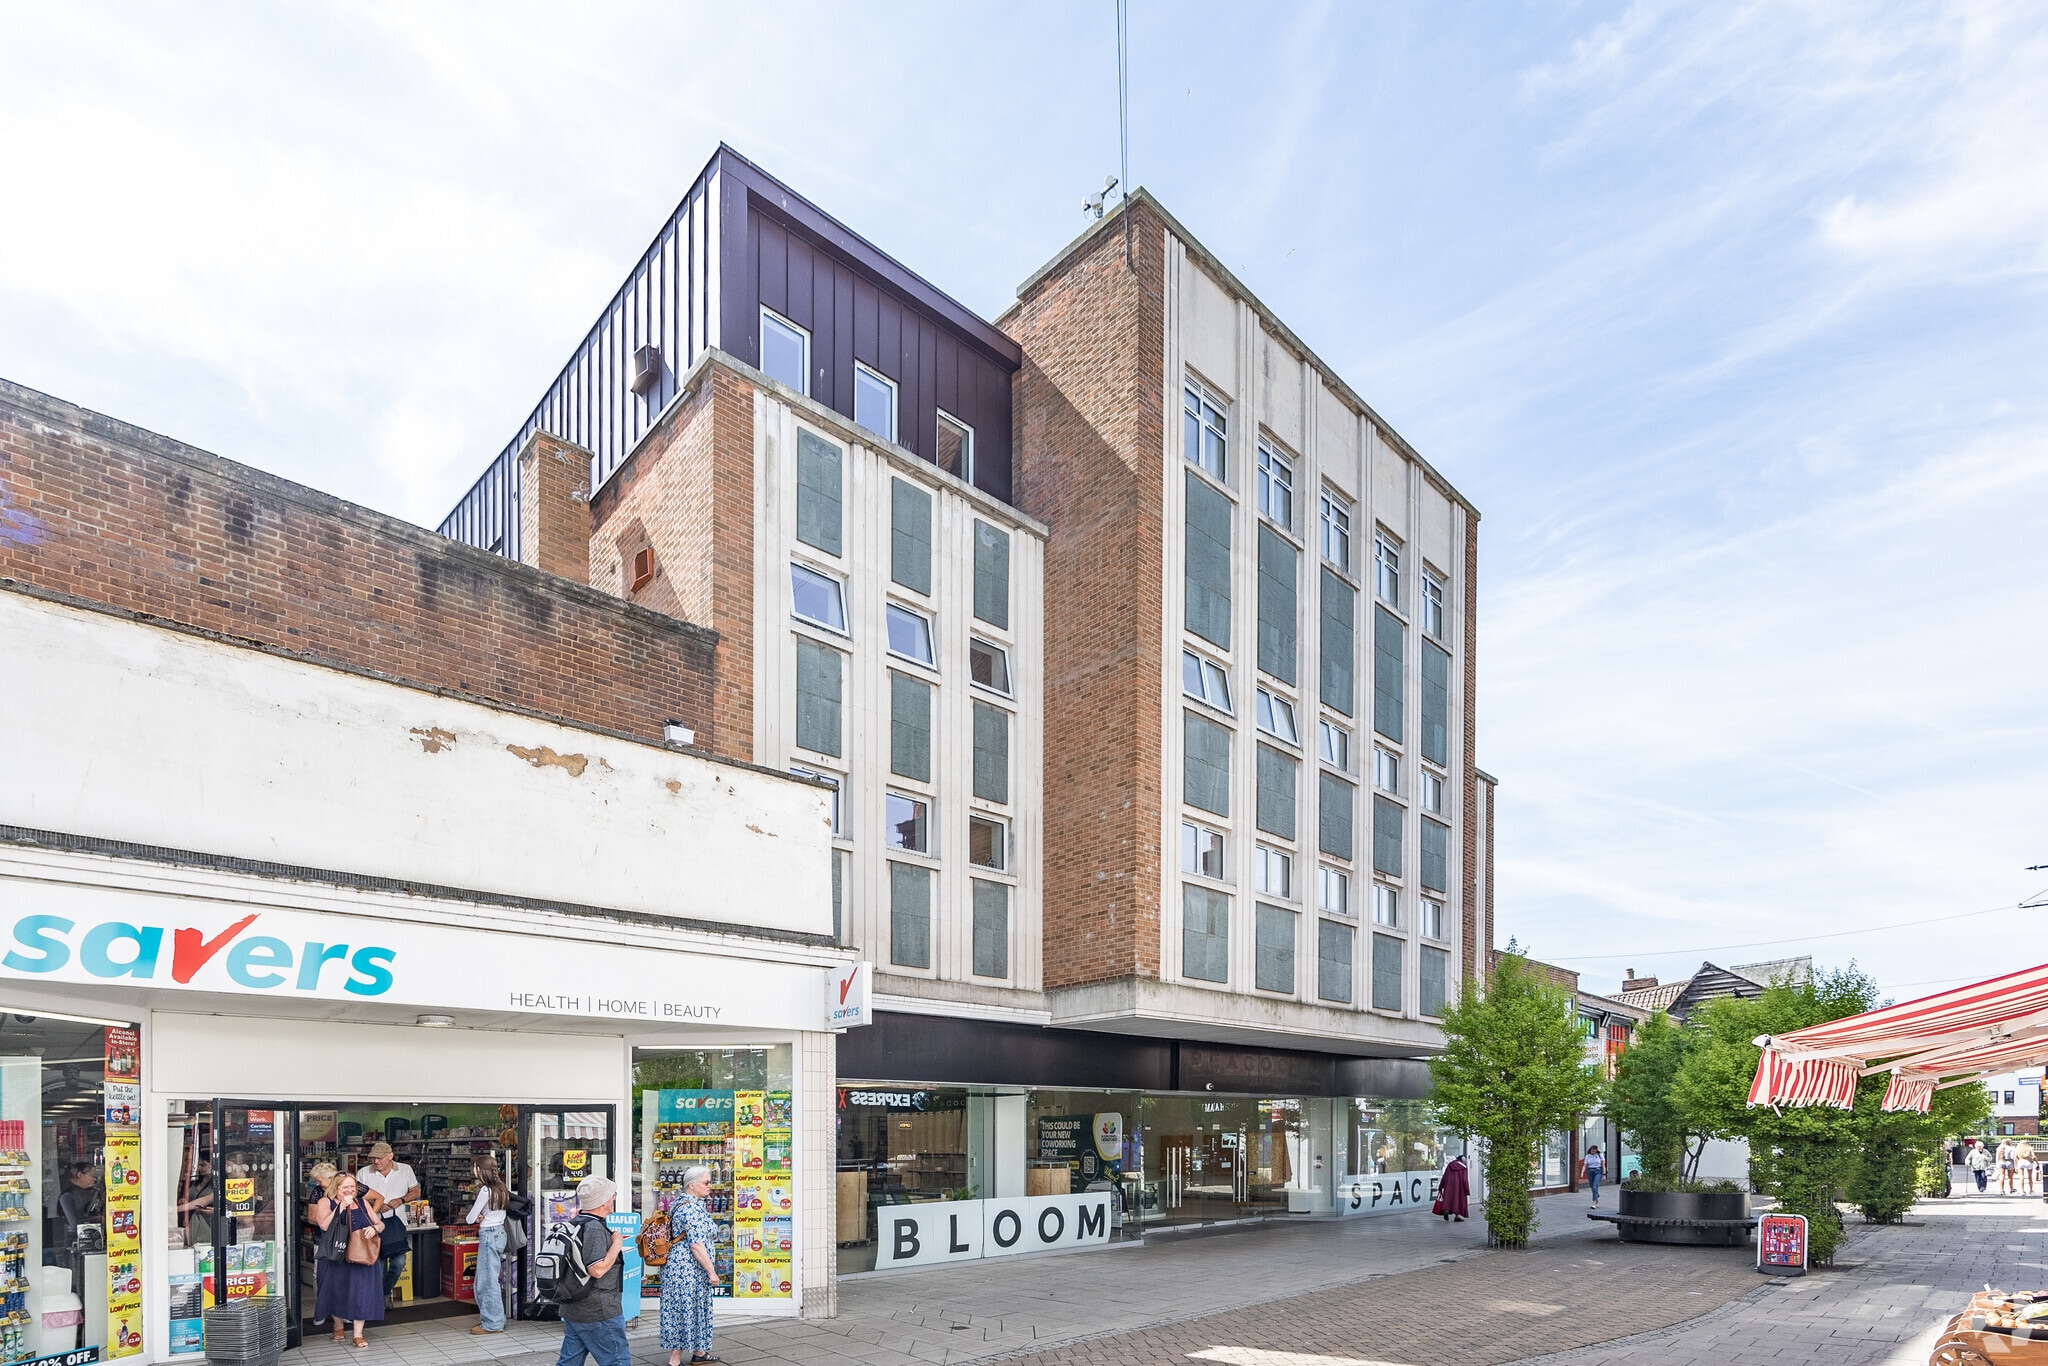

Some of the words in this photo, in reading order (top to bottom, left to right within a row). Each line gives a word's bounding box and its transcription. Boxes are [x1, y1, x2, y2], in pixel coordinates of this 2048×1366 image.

[2, 912, 397, 996] savers
[510, 992, 579, 1010] HEALTH
[598, 998, 648, 1015] HOME
[663, 1003, 721, 1019] BEAUTY
[833, 1005, 860, 1020] savers
[675, 1094, 732, 1109] savers
[306, 1114, 333, 1123] PRICE
[1042, 1121, 1054, 1130] THIS
[1054, 1121, 1073, 1130] COULD
[1074, 1121, 1081, 1130] BE
[1042, 1131, 1057, 1139] YOUR
[1058, 1131, 1071, 1139] NEW
[107, 1139, 122, 1147] LOW
[1042, 1140, 1076, 1148] COWORKING
[567, 1151, 585, 1159] LOW
[1042, 1149, 1058, 1157] SPACE
[227, 1180, 252, 1190] LOW
[108, 1193, 123, 1202] LOW
[1351, 1178, 1439, 1209] SPACE
[607, 1215, 637, 1224] LEAFLET
[893, 1203, 1105, 1260] BLOOM
[109, 1249, 124, 1257] LOW
[124, 1248, 139, 1256] PRICE
[227, 1285, 254, 1295] ROP
[110, 1303, 125, 1313] LOW
[125, 1302, 141, 1311] PRICE
